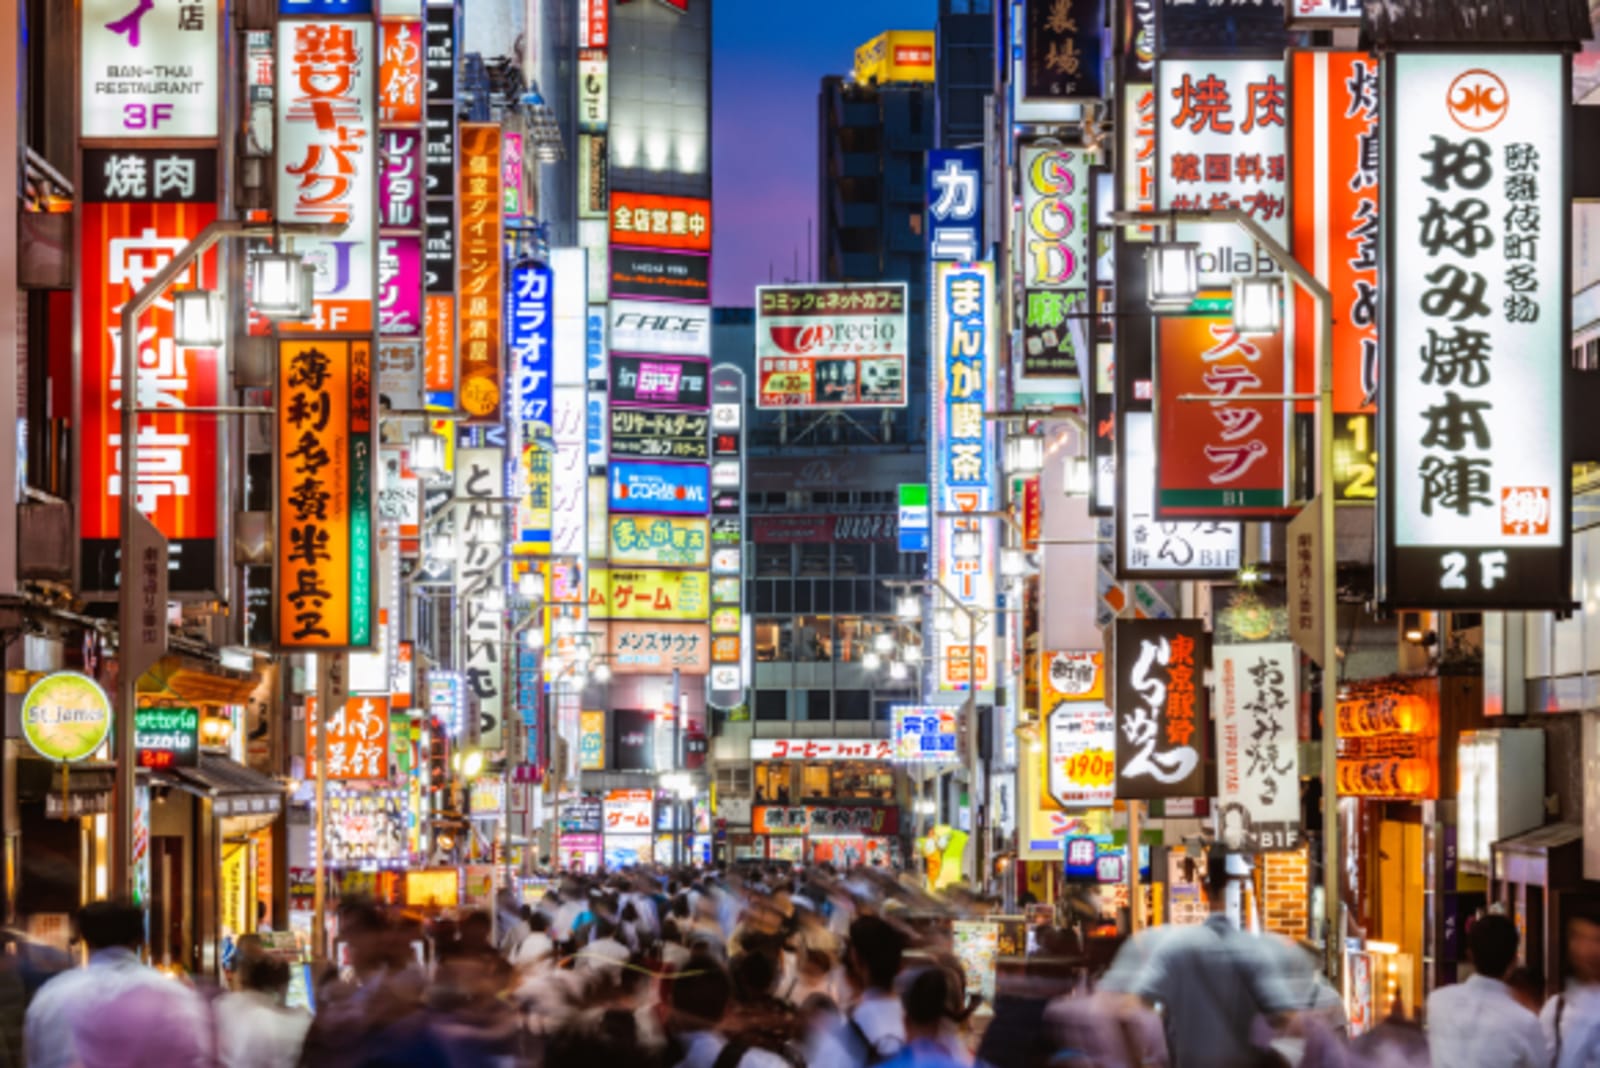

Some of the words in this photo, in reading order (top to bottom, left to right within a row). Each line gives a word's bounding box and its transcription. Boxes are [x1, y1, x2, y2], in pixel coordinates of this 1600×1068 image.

[95, 82, 204, 95] RESTAURANT
[123, 104, 174, 129] 3F
[105, 156, 196, 198] 焼肉
[389, 132, 414, 225] レンタル
[1196, 247, 1285, 273] ollab
[516, 268, 548, 394] カラオケ
[1418, 135, 1494, 517] お好み焼本陣
[1202, 322, 1266, 484] ステップ
[1439, 550, 1507, 590] 2F
[614, 585, 673, 613] ゲーム
[771, 739, 832, 759] コーヒー
